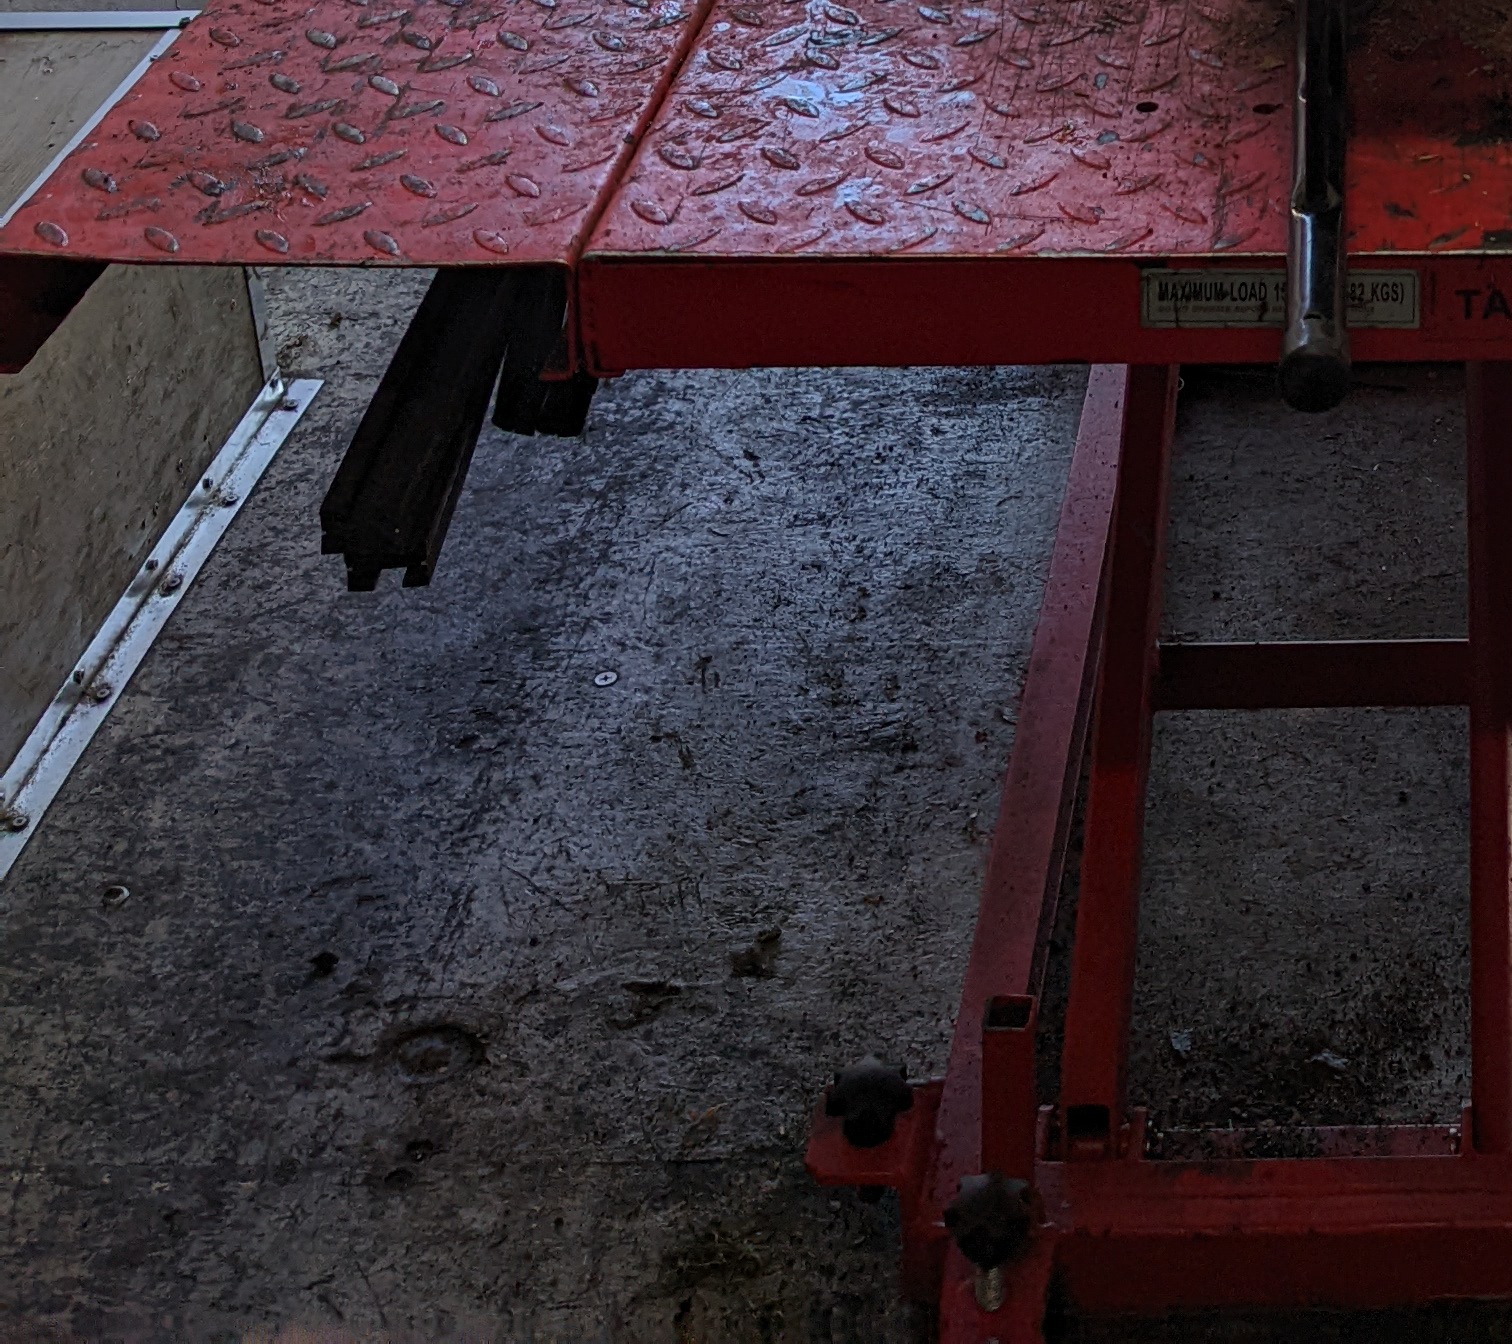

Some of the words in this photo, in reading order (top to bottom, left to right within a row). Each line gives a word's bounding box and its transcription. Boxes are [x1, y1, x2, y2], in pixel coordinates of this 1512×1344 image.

[1157, 281, 1225, 302] MAXIMUM
[1230, 281, 1268, 302] LOAD
[1370, 282, 1405, 305] KGS)
